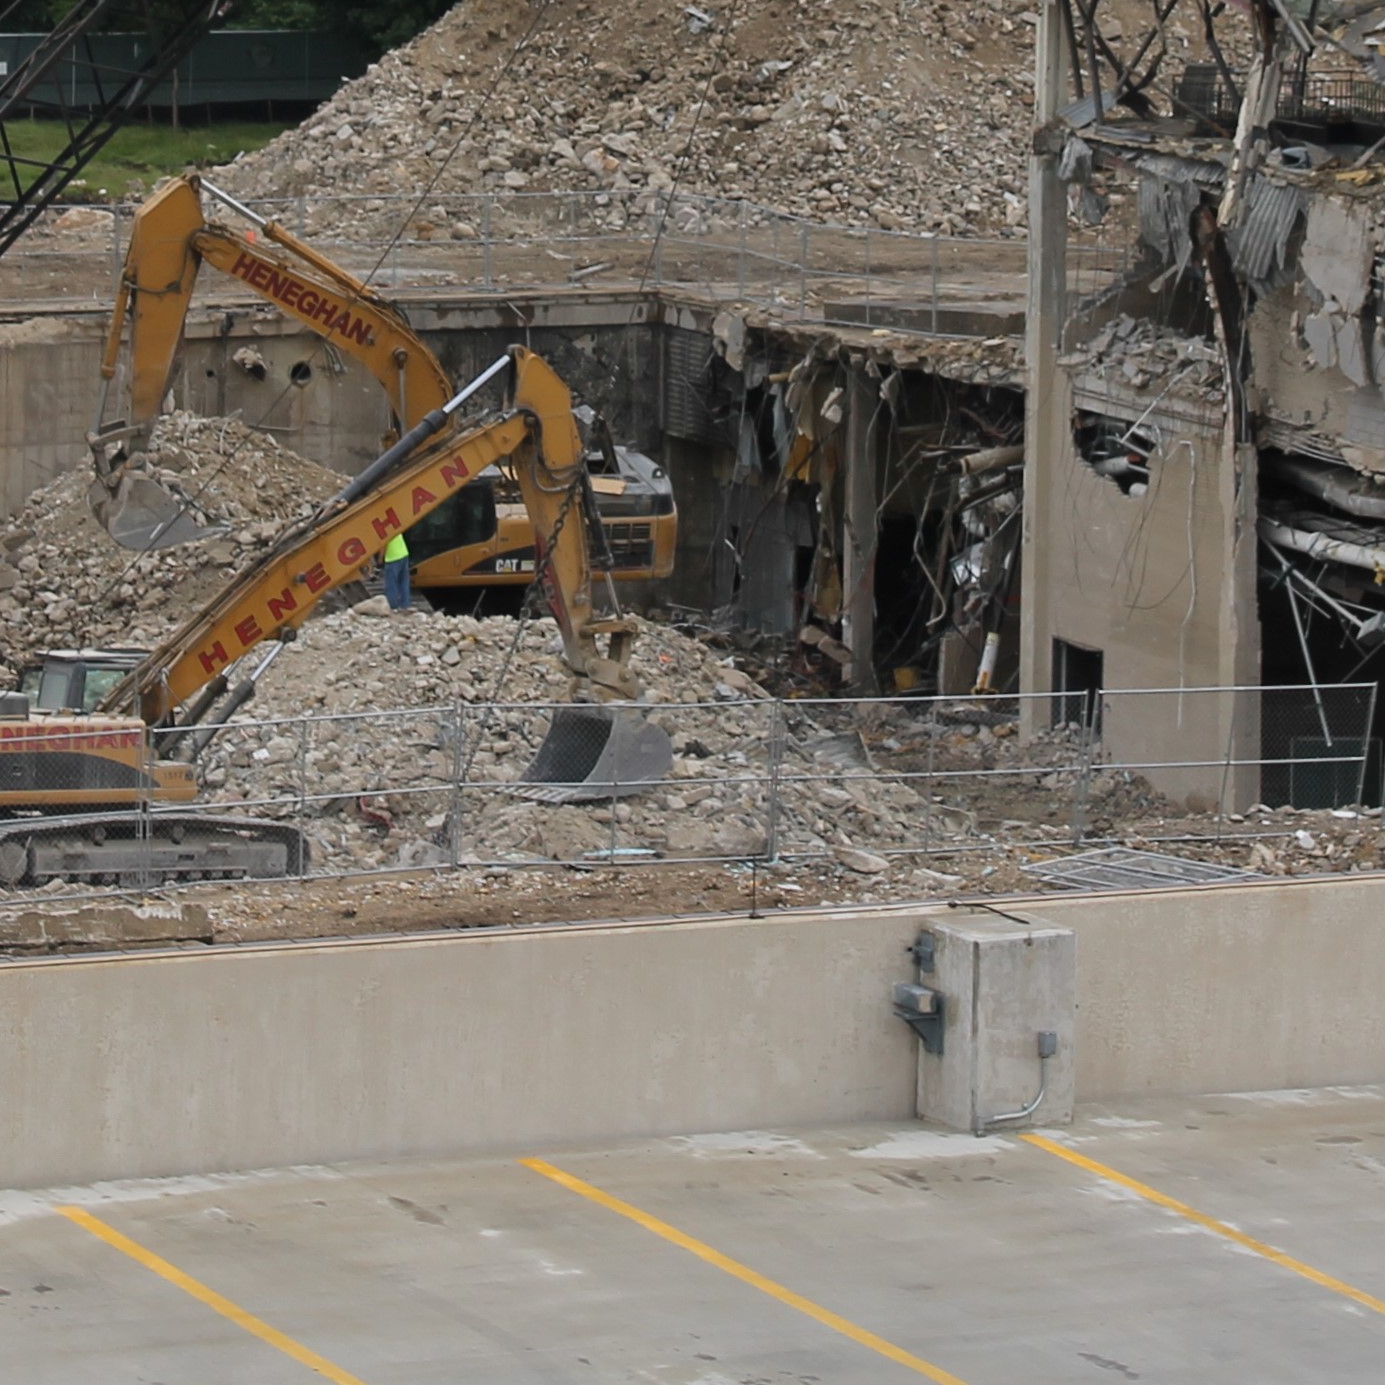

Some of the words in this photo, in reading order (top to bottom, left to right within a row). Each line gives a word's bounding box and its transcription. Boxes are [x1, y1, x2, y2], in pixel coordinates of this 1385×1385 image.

[231, 253, 373, 345] HENEGHAN
[198, 456, 470, 674] HENEGHAN
[496, 559, 518, 572] CAT
